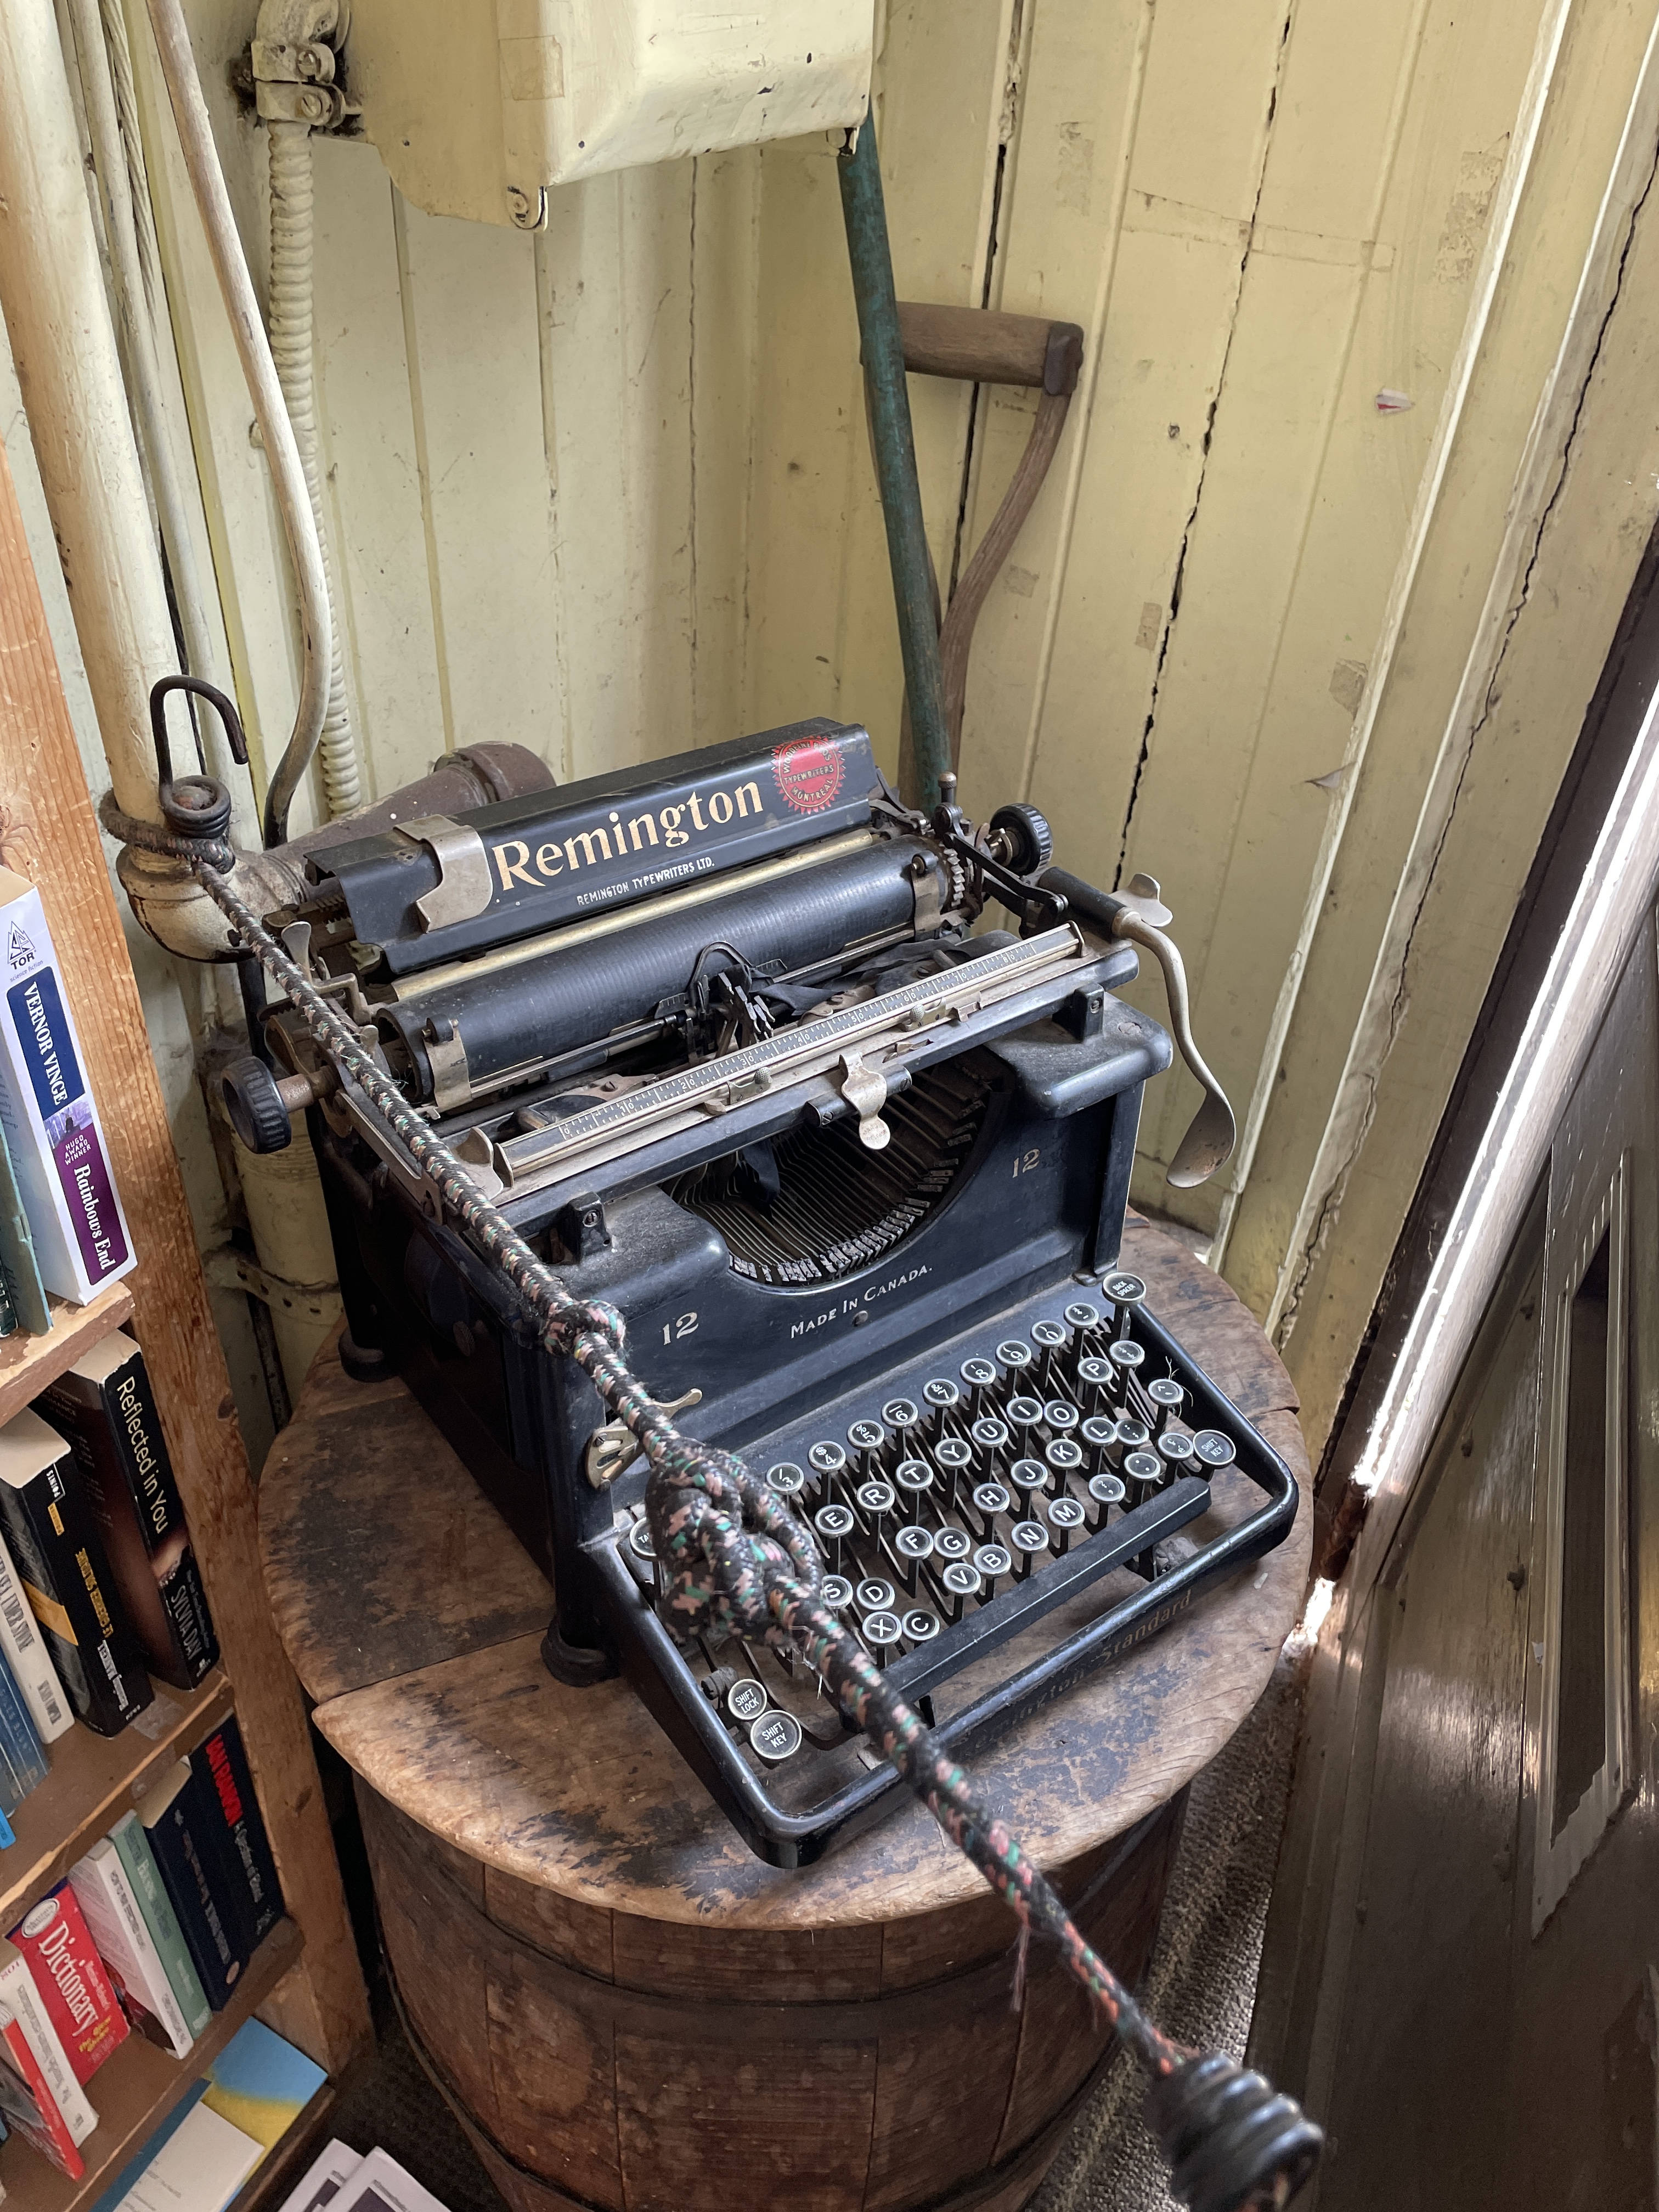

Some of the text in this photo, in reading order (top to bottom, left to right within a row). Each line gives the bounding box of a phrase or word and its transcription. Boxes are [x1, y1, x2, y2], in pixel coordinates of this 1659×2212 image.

[783, 764, 834, 785] TYPEWRITERS
[791, 778, 834, 802] MONTREAL
[492, 781, 763, 891] Remington
[577, 856, 715, 906] REMINGTON TYPEWRITERS LTD.
[11, 952, 35, 970] TOR
[10, 960, 43, 983] science fiction
[24, 981, 68, 1105] VERNOR VINGE
[65, 1135, 84, 1150] HUGO
[65, 1139, 88, 1159] AWARD
[64, 1144, 92, 1165] WINNER
[1012, 1148, 1040, 1178] 12
[74, 1164, 116, 1270] Rainbows End
[1112, 1280, 1127, 1291] BACK
[1117, 1283, 1136, 1296] SPACER
[662, 1312, 699, 1345] 12
[791, 1308, 837, 1339] MADE
[1086, 1362, 1100, 1376] P
[1053, 1407, 1070, 1421] O
[980, 1424, 998, 1438] U
[1090, 1426, 1108, 1437] L
[943, 1444, 960, 1459] Y
[1053, 1444, 1073, 1460] K
[1200, 1437, 1218, 1452] SHIFT
[1210, 1446, 1224, 1457] KEY
[116, 1376, 168, 1534] Reflected in You
[905, 1467, 921, 1481] T
[1024, 1466, 1036, 1480] J
[864, 1488, 886, 1504] R
[980, 1490, 1000, 1505] H
[824, 1511, 844, 1528] E
[1054, 1504, 1076, 1521] M
[905, 1533, 918, 1549] F
[944, 1535, 962, 1550] G
[1020, 1528, 1040, 1545] N
[983, 1553, 1002, 1568] B
[951, 1570, 968, 1585] V
[824, 1583, 841, 1598] S
[865, 1585, 883, 1602] D
[171, 1584, 194, 1638] SYLVIA
[183, 1628, 202, 1661] DAY
[870, 1618, 893, 1637] X
[911, 1617, 929, 1632] C
[1101, 1589, 1192, 1663] Standard
[735, 1688, 754, 1706] SHIFT
[741, 1697, 760, 1714] LOCK
[761, 1722, 784, 1741] SHIFT
[770, 1733, 787, 1748] KEY
[38, 1920, 99, 2038] Dictionary
